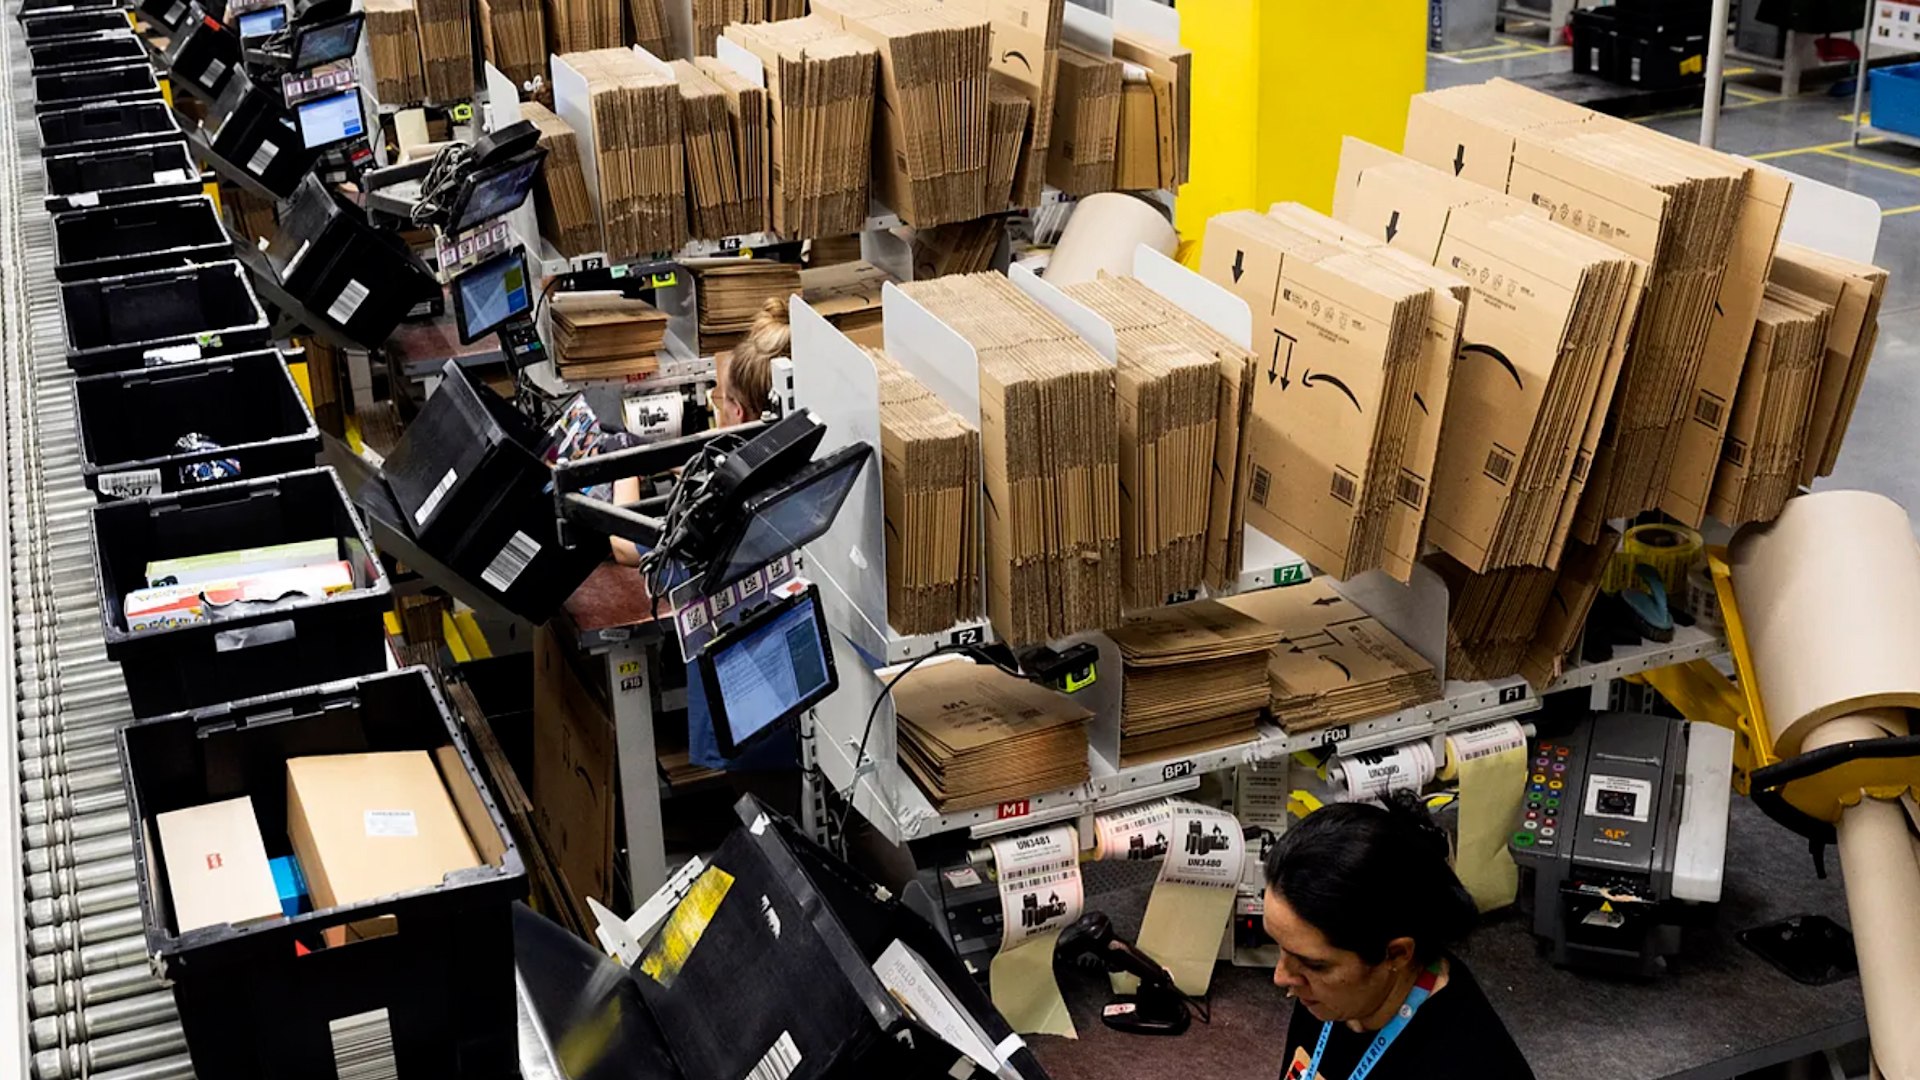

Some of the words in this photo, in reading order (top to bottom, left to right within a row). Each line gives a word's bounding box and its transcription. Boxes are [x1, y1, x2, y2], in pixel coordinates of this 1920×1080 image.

[587, 260, 599, 270] F2
[1280, 566, 1298, 581] F7
[959, 630, 977, 645] F2
[1506, 687, 1520, 701] F1
[1325, 728, 1347, 743] F0a
[1165, 762, 1190, 779] BP1
[1002, 802, 1025, 817] M1
[1016, 835, 1051, 851] UN3481
[1187, 858, 1222, 868] UN3480
[893, 959, 917, 987] HELLO
